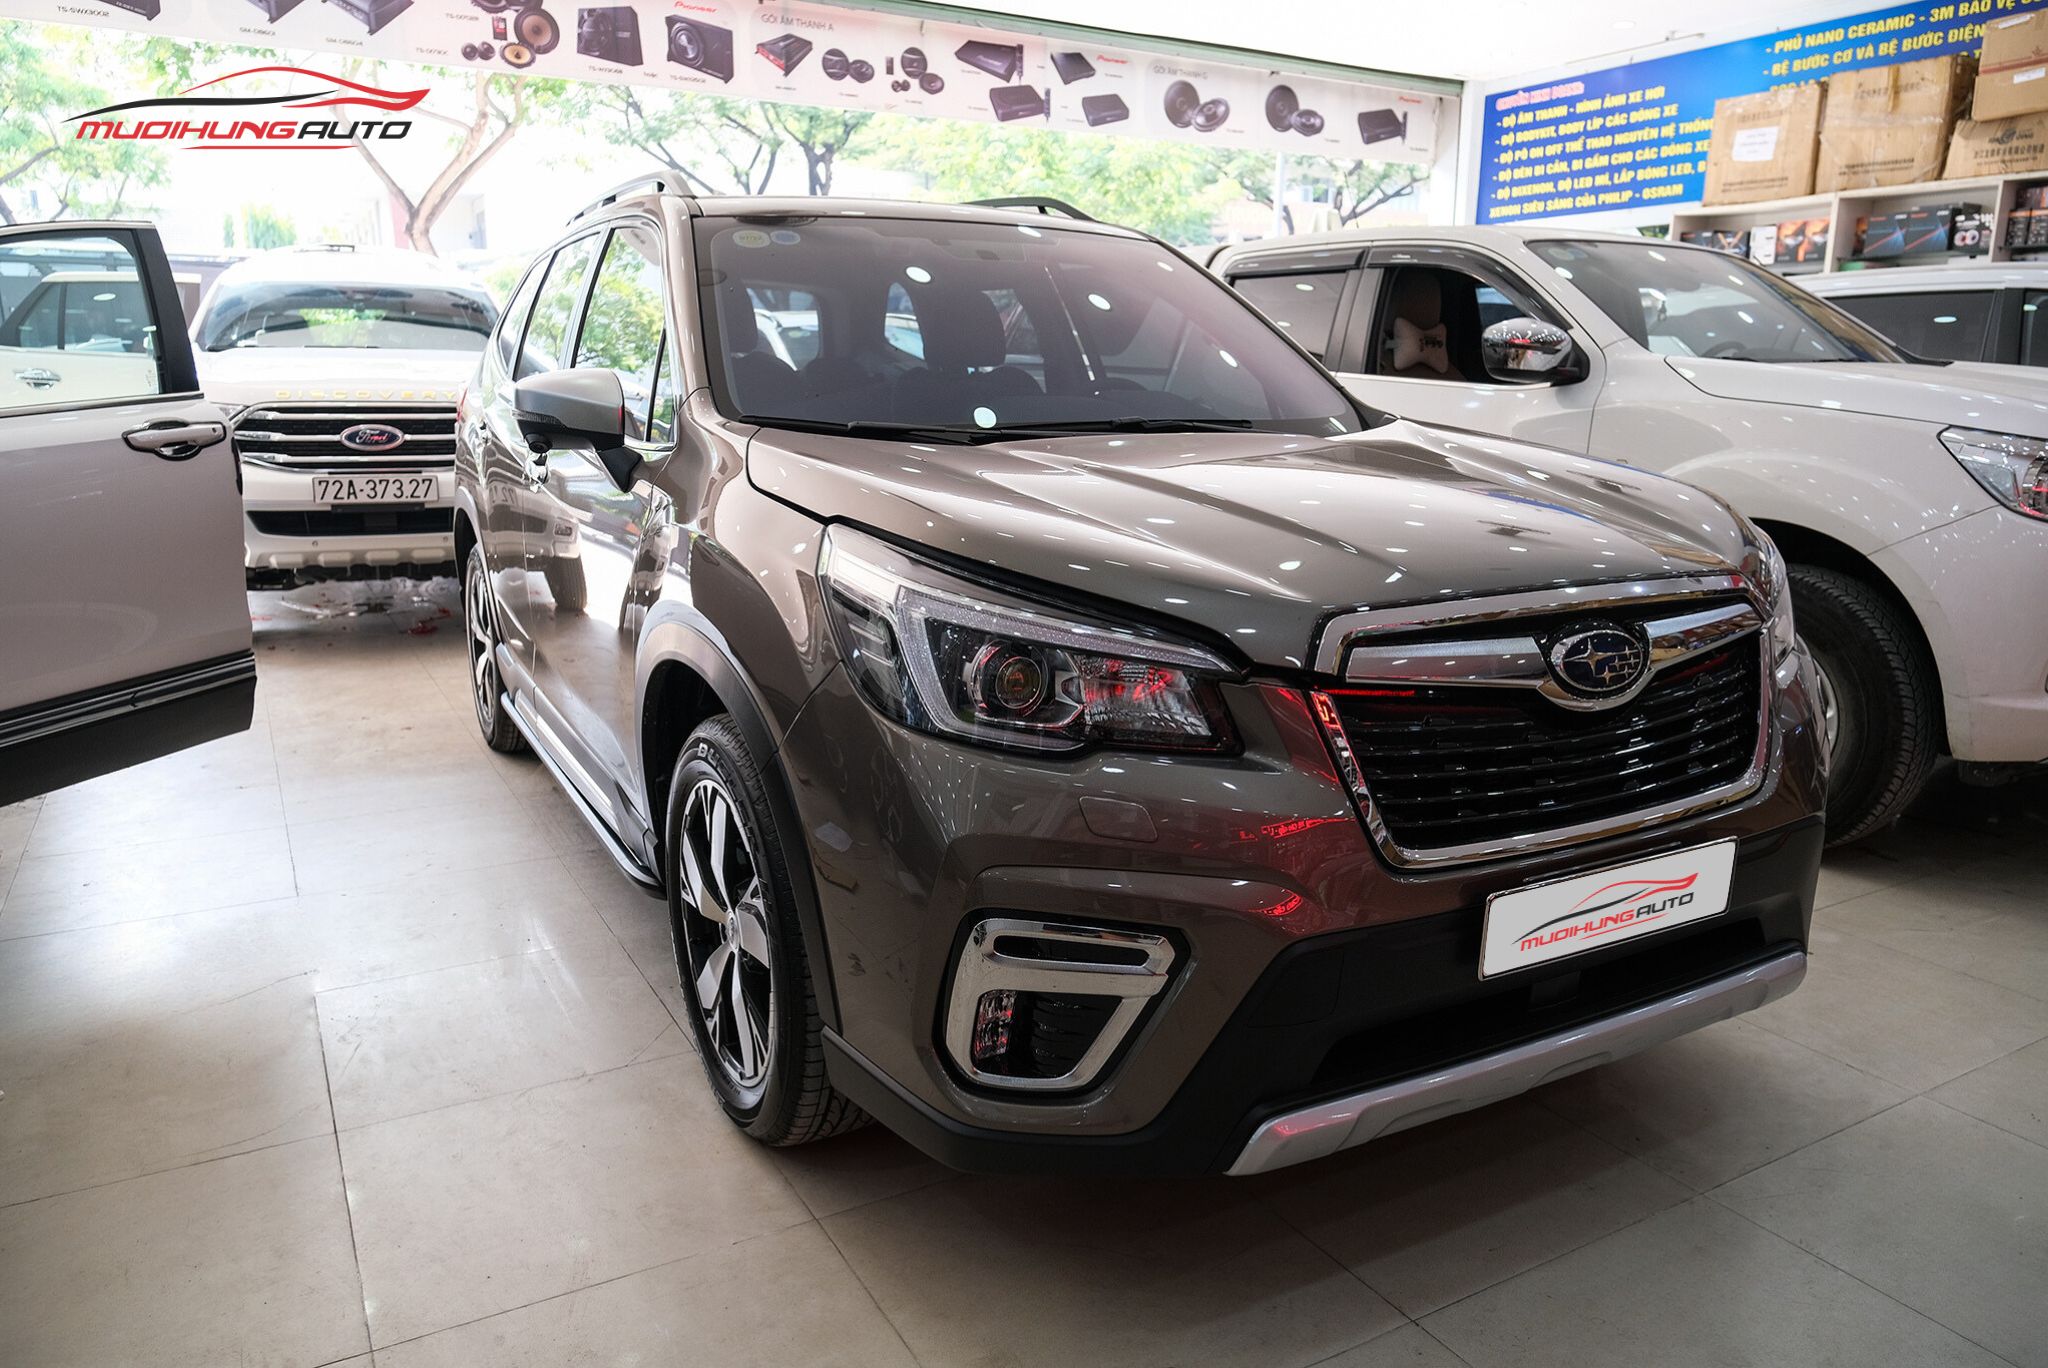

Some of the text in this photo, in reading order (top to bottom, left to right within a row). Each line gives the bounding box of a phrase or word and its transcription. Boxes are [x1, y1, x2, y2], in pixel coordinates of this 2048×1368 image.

[1805, 28, 1845, 48] NANO
[1847, 13, 1916, 39] CERAMIC
[1929, 5, 1955, 23] 3M
[1856, 42, 1875, 60] VÀ
[1628, 90, 1643, 104] XE
[1663, 103, 1679, 118] XE
[1695, 139, 1711, 153] XE
[1573, 175, 1594, 190] LED
[1642, 183, 1684, 200] OSRAM
[275, 389, 456, 399] DISCOVERY
[354, 430, 390, 445] Ford
[317, 477, 433, 500] 72A-373.27
